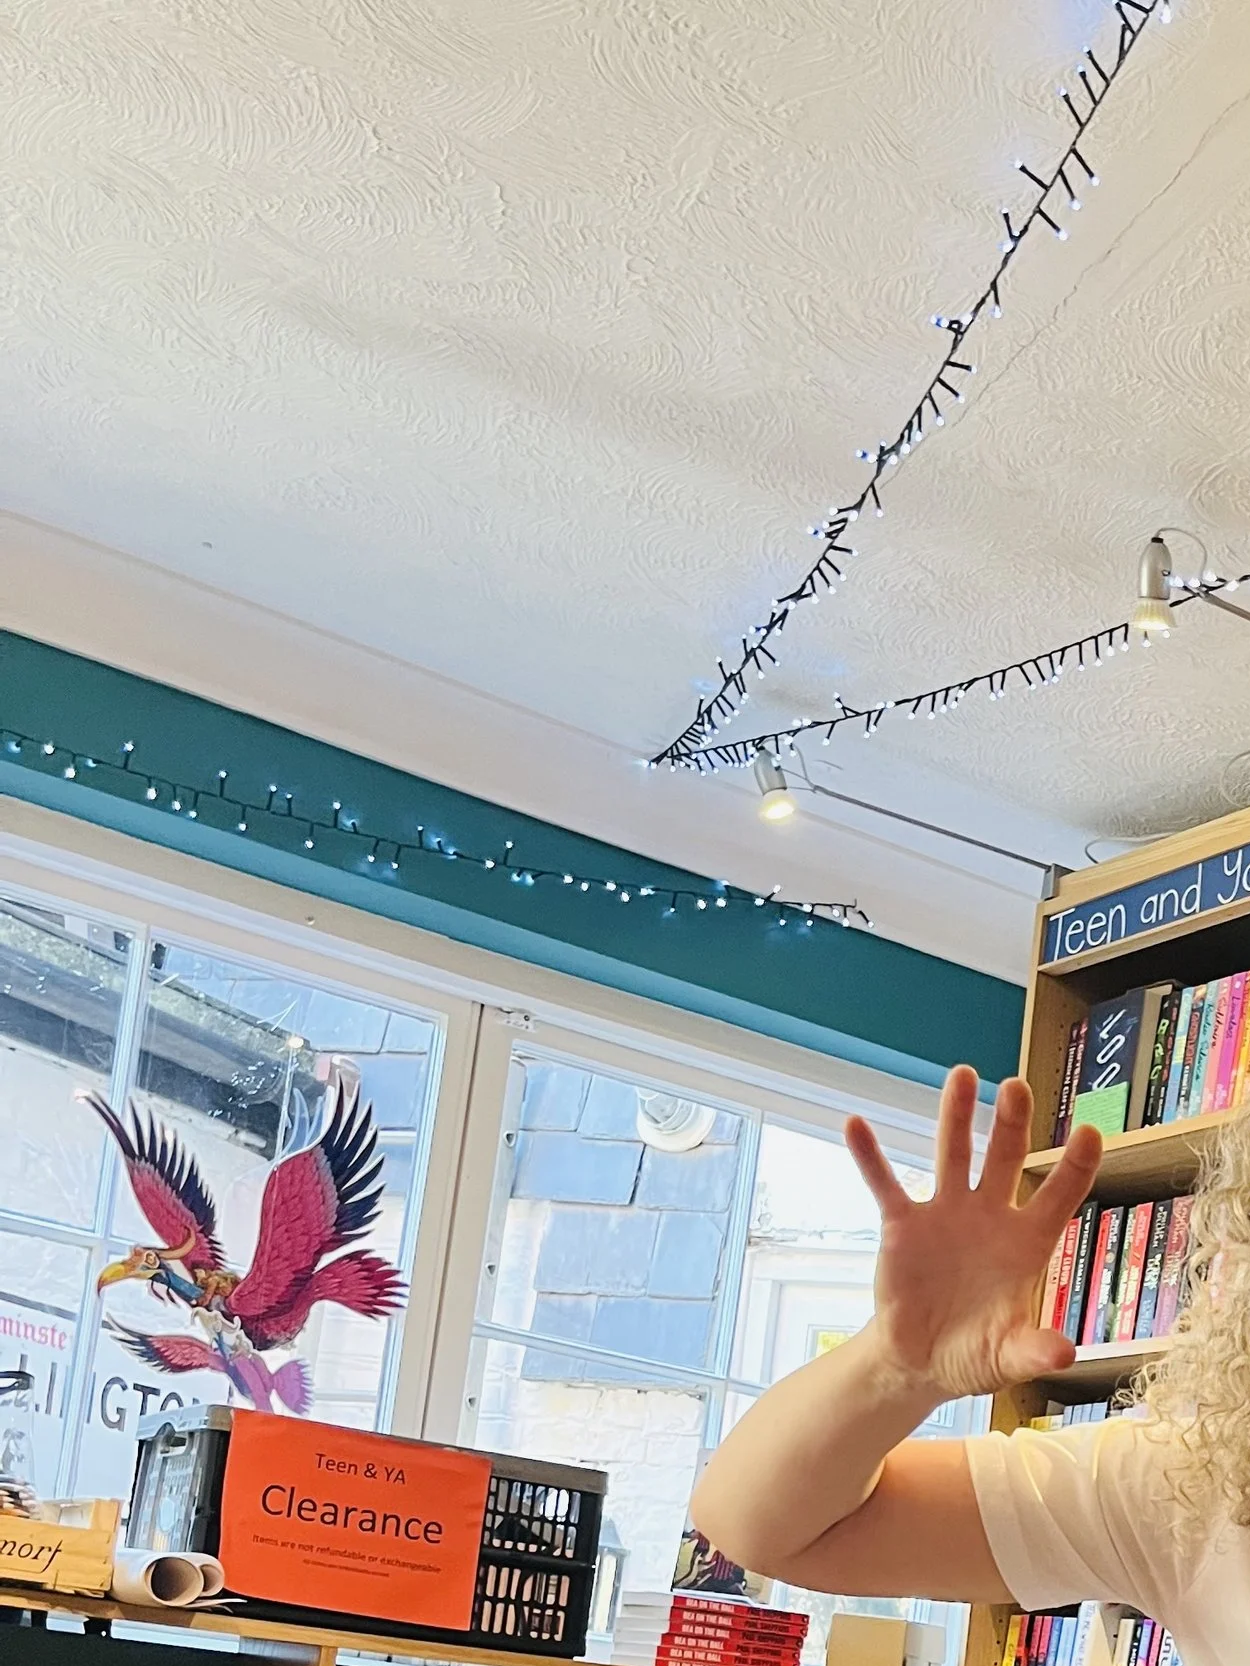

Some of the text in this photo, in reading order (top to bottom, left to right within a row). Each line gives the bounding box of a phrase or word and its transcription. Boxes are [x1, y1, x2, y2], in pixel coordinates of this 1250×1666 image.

[1048, 906, 1127, 959] Teen
[1140, 866, 1203, 927] and
[0, 1317, 67, 1350] minste
[315, 1452, 407, 1486] Teen & YA
[260, 1483, 444, 1545] Clearance
